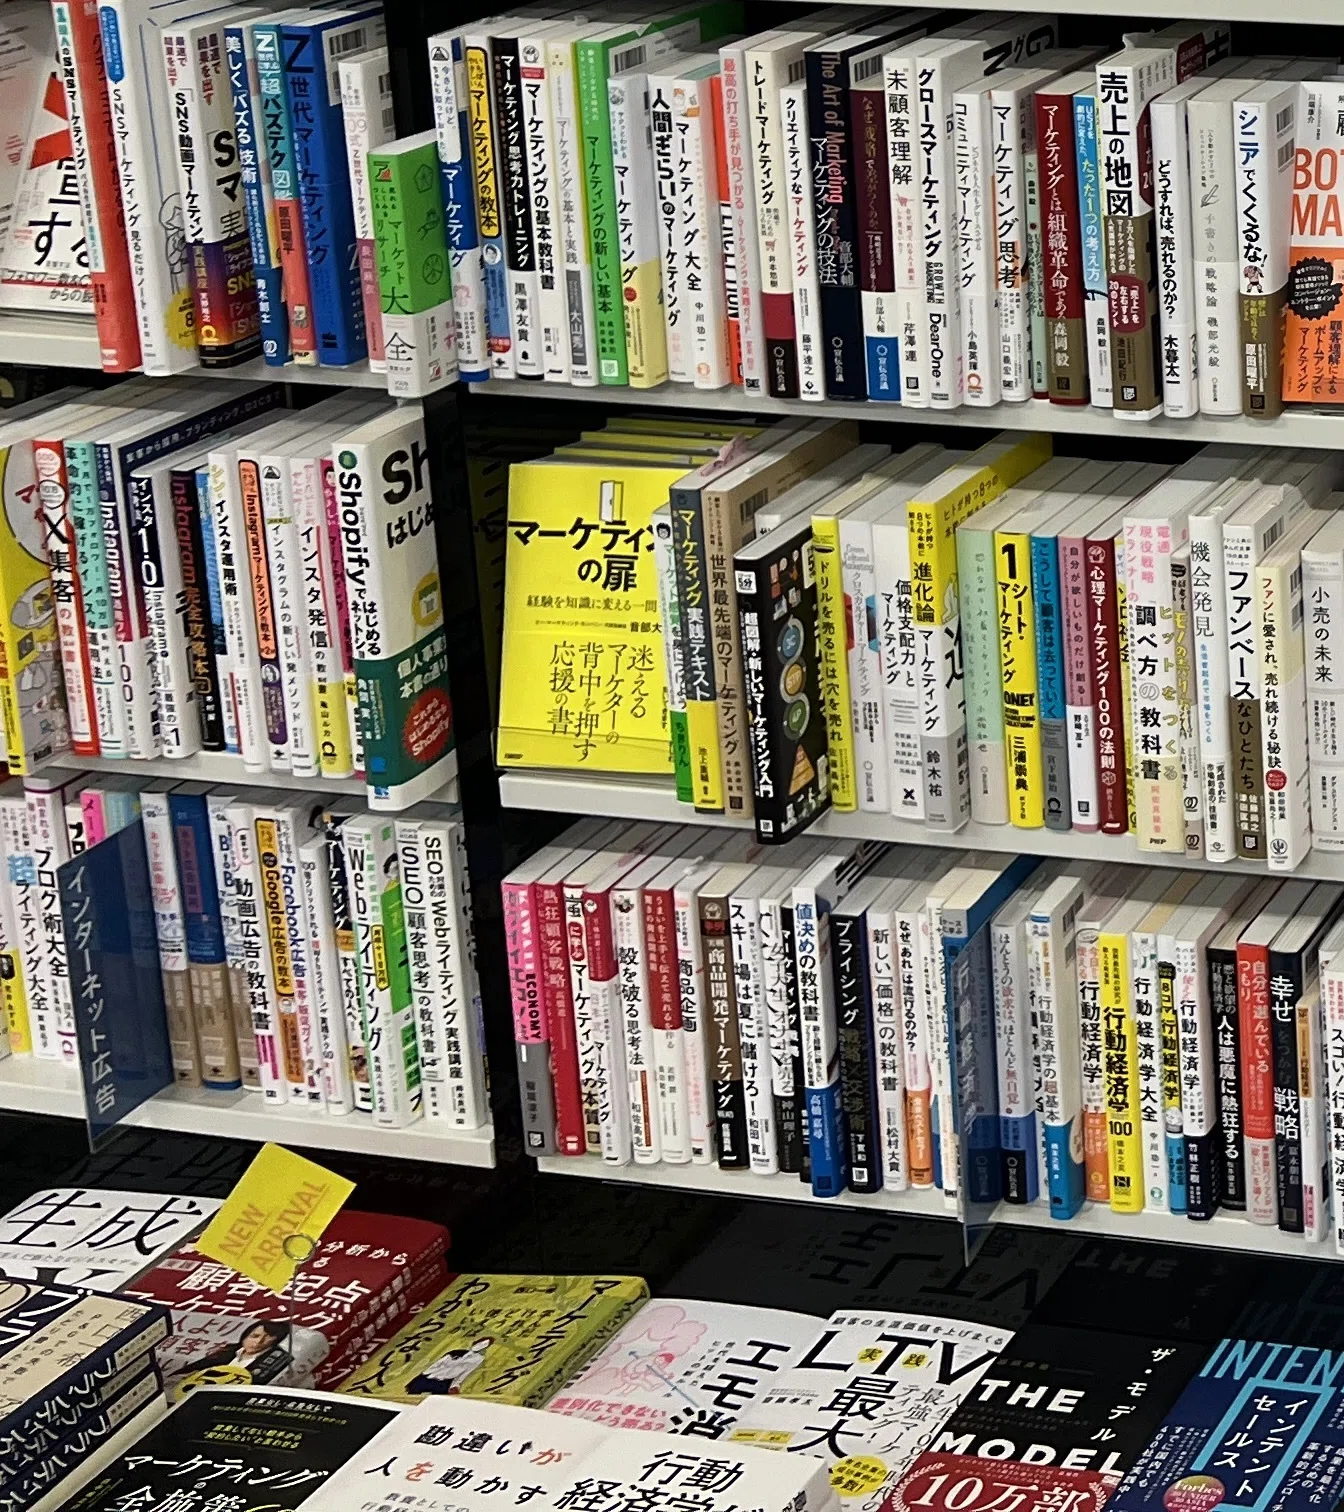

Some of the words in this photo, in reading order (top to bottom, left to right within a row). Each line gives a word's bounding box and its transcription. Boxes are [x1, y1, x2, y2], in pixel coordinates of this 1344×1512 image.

[753, 61, 774, 206] トレードマーケティング
[887, 69, 914, 186] 未顧客理解
[919, 68, 943, 258] グロースマーケティング
[1100, 71, 1134, 216] 売上の地図
[524, 83, 555, 290] マーケティングの基本教科書
[812, 138, 840, 286] マーケティングの技法
[992, 105, 1021, 290] マーケティング思考
[338, 473, 368, 591] Shopify
[577, 554, 638, 592] の扉
[547, 641, 576, 735] 応援の書
[627, 645, 654, 718] 迷える
[1228, 569, 1255, 700] ファンベース
[1311, 586, 1333, 685] 小売の未来
[67, 865, 117, 1117] インターネット広告
[795, 902, 822, 1023] 値決めの教科書
[218, 1205, 269, 1258] NEW
[250, 1181, 332, 1274] ARRIVAL
[933, 1430, 1125, 1474] MODEL
[977, 1378, 1086, 1413] THE
[364, 1458, 548, 1506] 人を動かす
